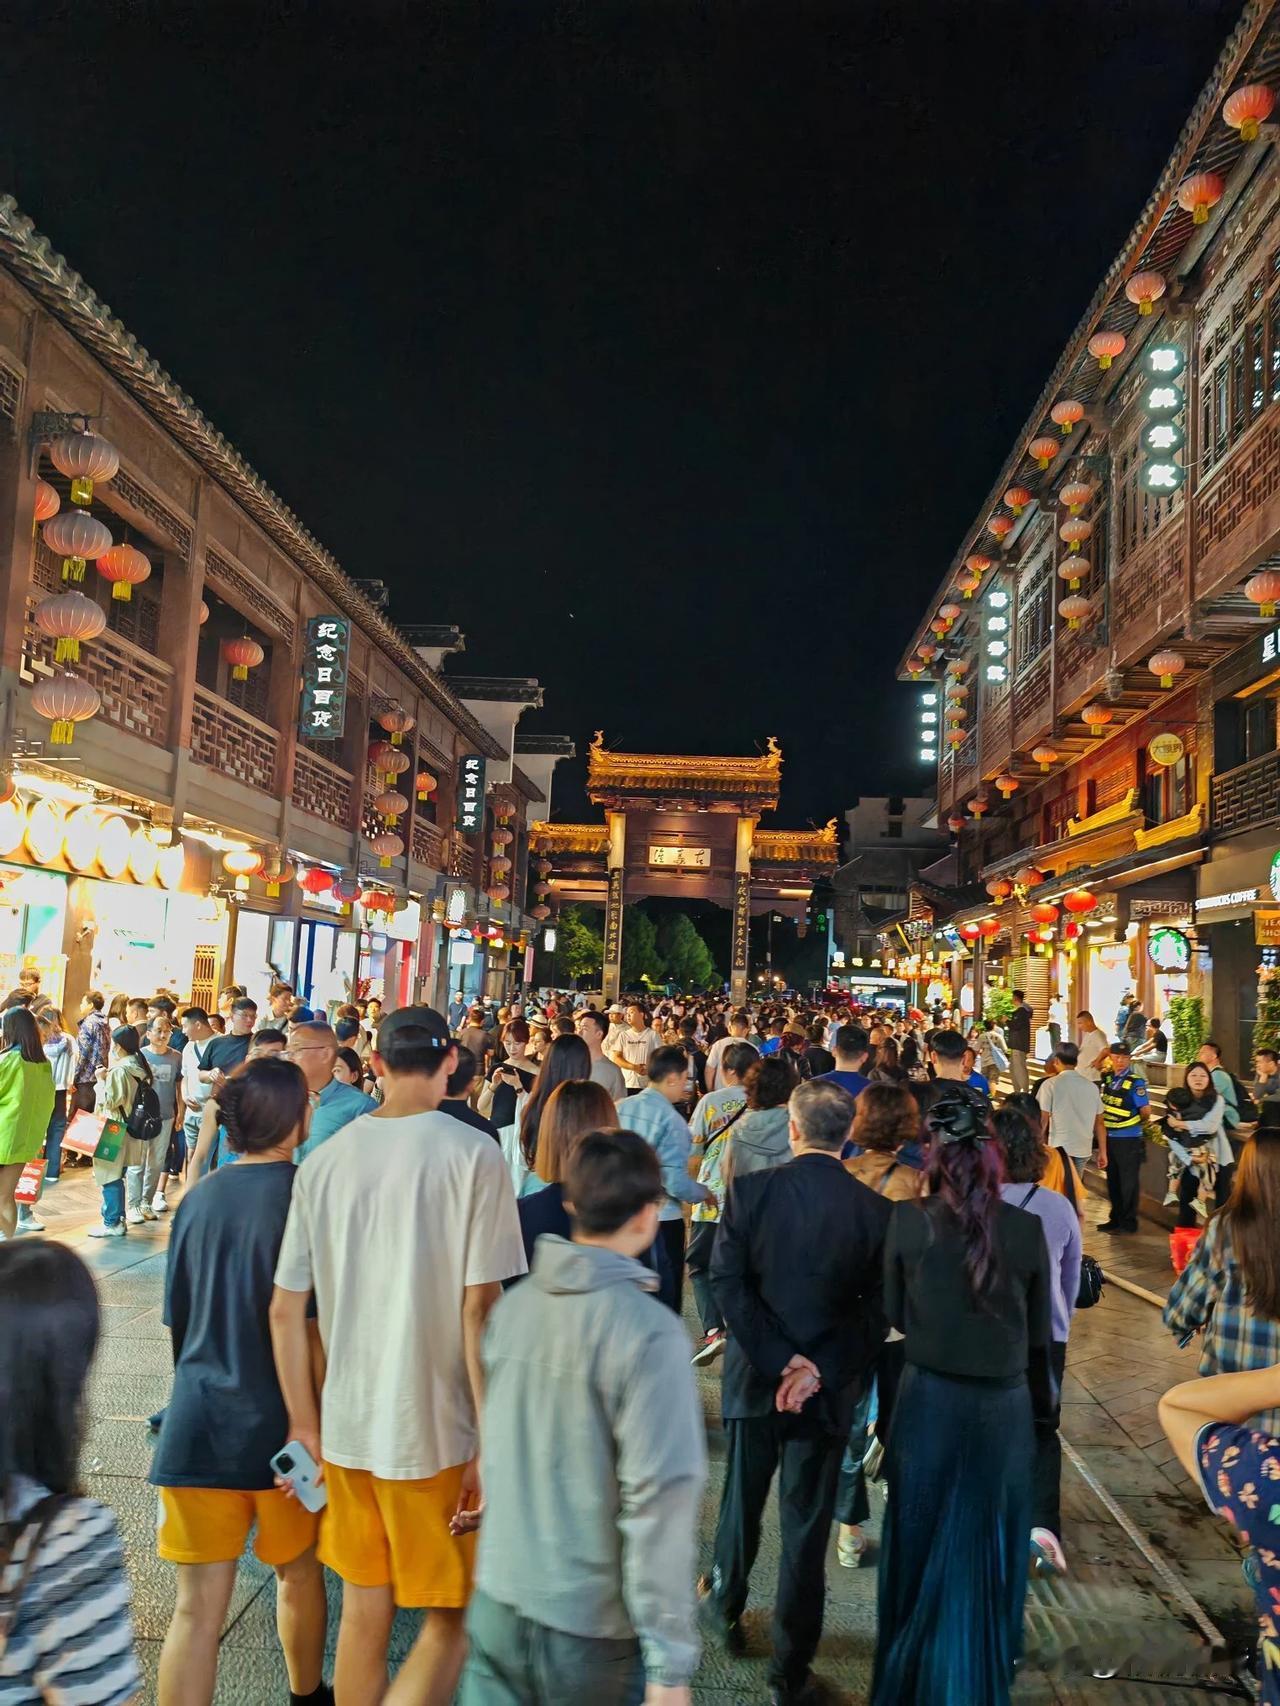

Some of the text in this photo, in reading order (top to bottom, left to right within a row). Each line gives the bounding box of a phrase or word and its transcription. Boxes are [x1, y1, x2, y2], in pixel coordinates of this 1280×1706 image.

[311, 623, 339, 727] 纪念日百货
[1262, 629, 1280, 663] 星
[462, 759, 480, 827] 纪念日百货
